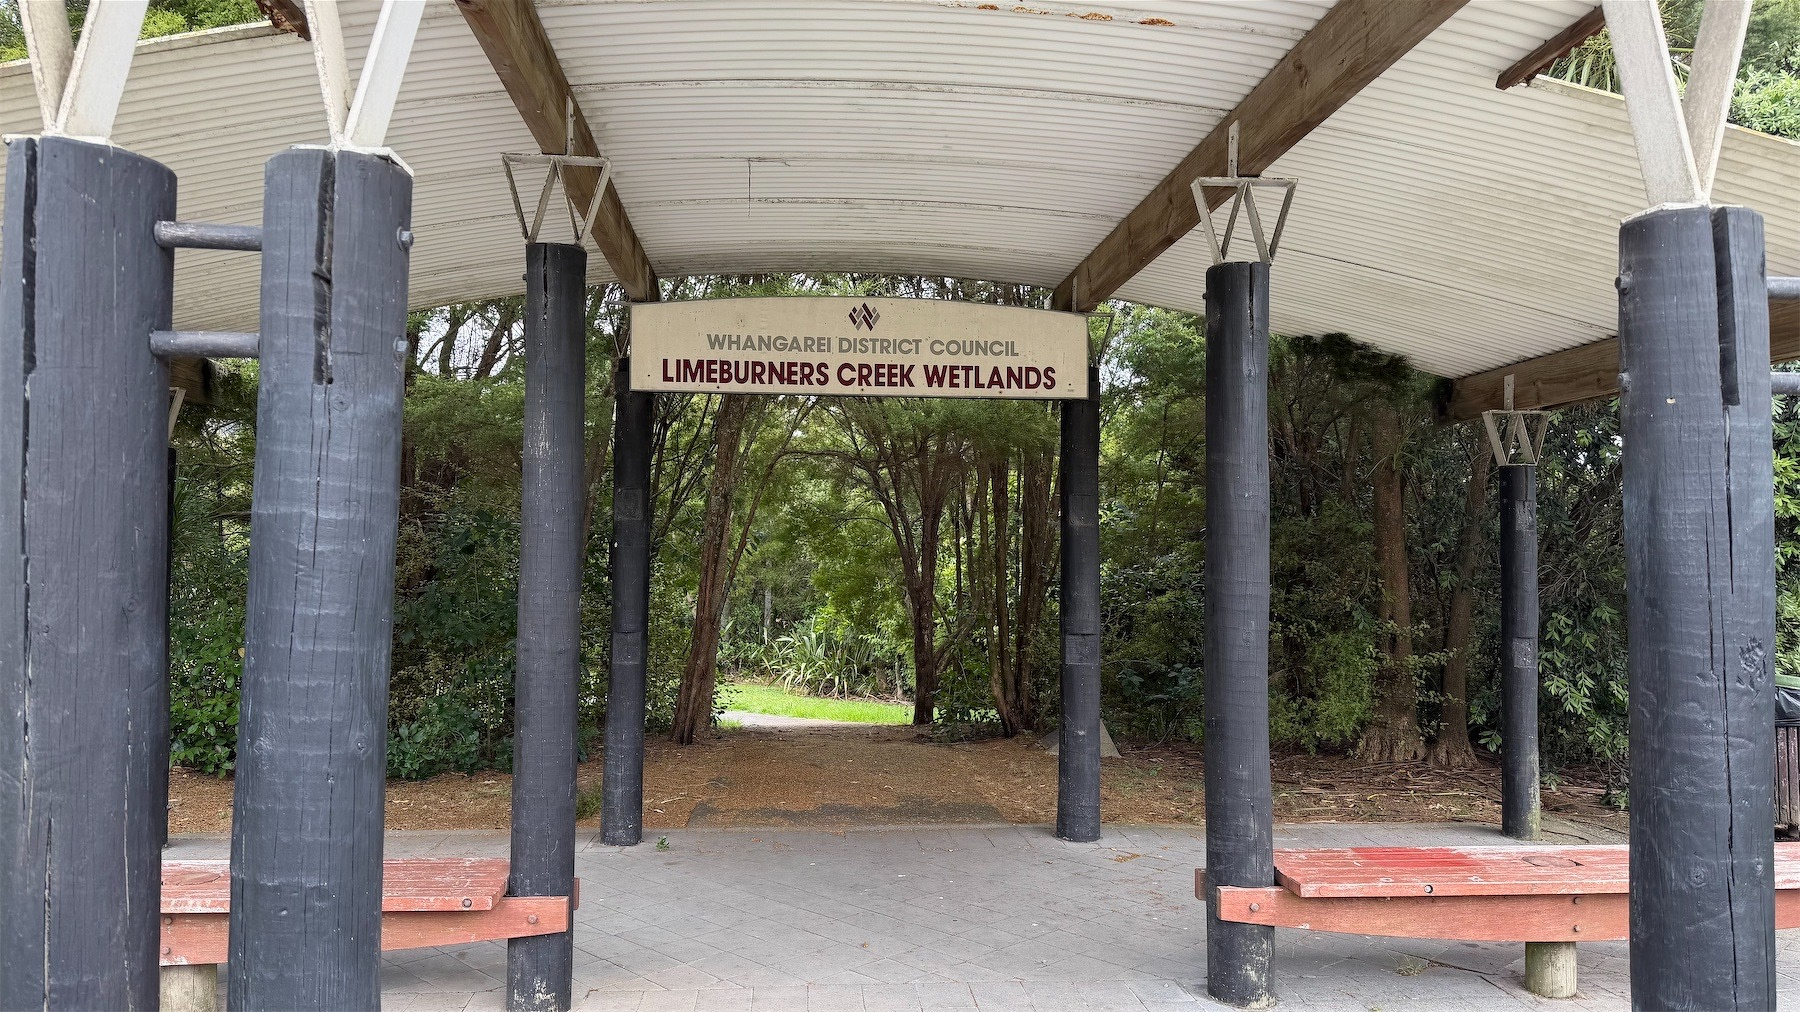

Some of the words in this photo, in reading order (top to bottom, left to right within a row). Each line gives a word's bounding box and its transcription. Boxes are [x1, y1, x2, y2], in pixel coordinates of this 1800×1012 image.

[706, 334, 832, 352] WHANGAREI
[838, 337, 922, 355] DISTRICT
[930, 340, 1019, 357] COUNCIL
[662, 359, 829, 386] LIMEBURNERS
[836, 363, 915, 387] CREEK
[923, 365, 1056, 390] WETLANDS
